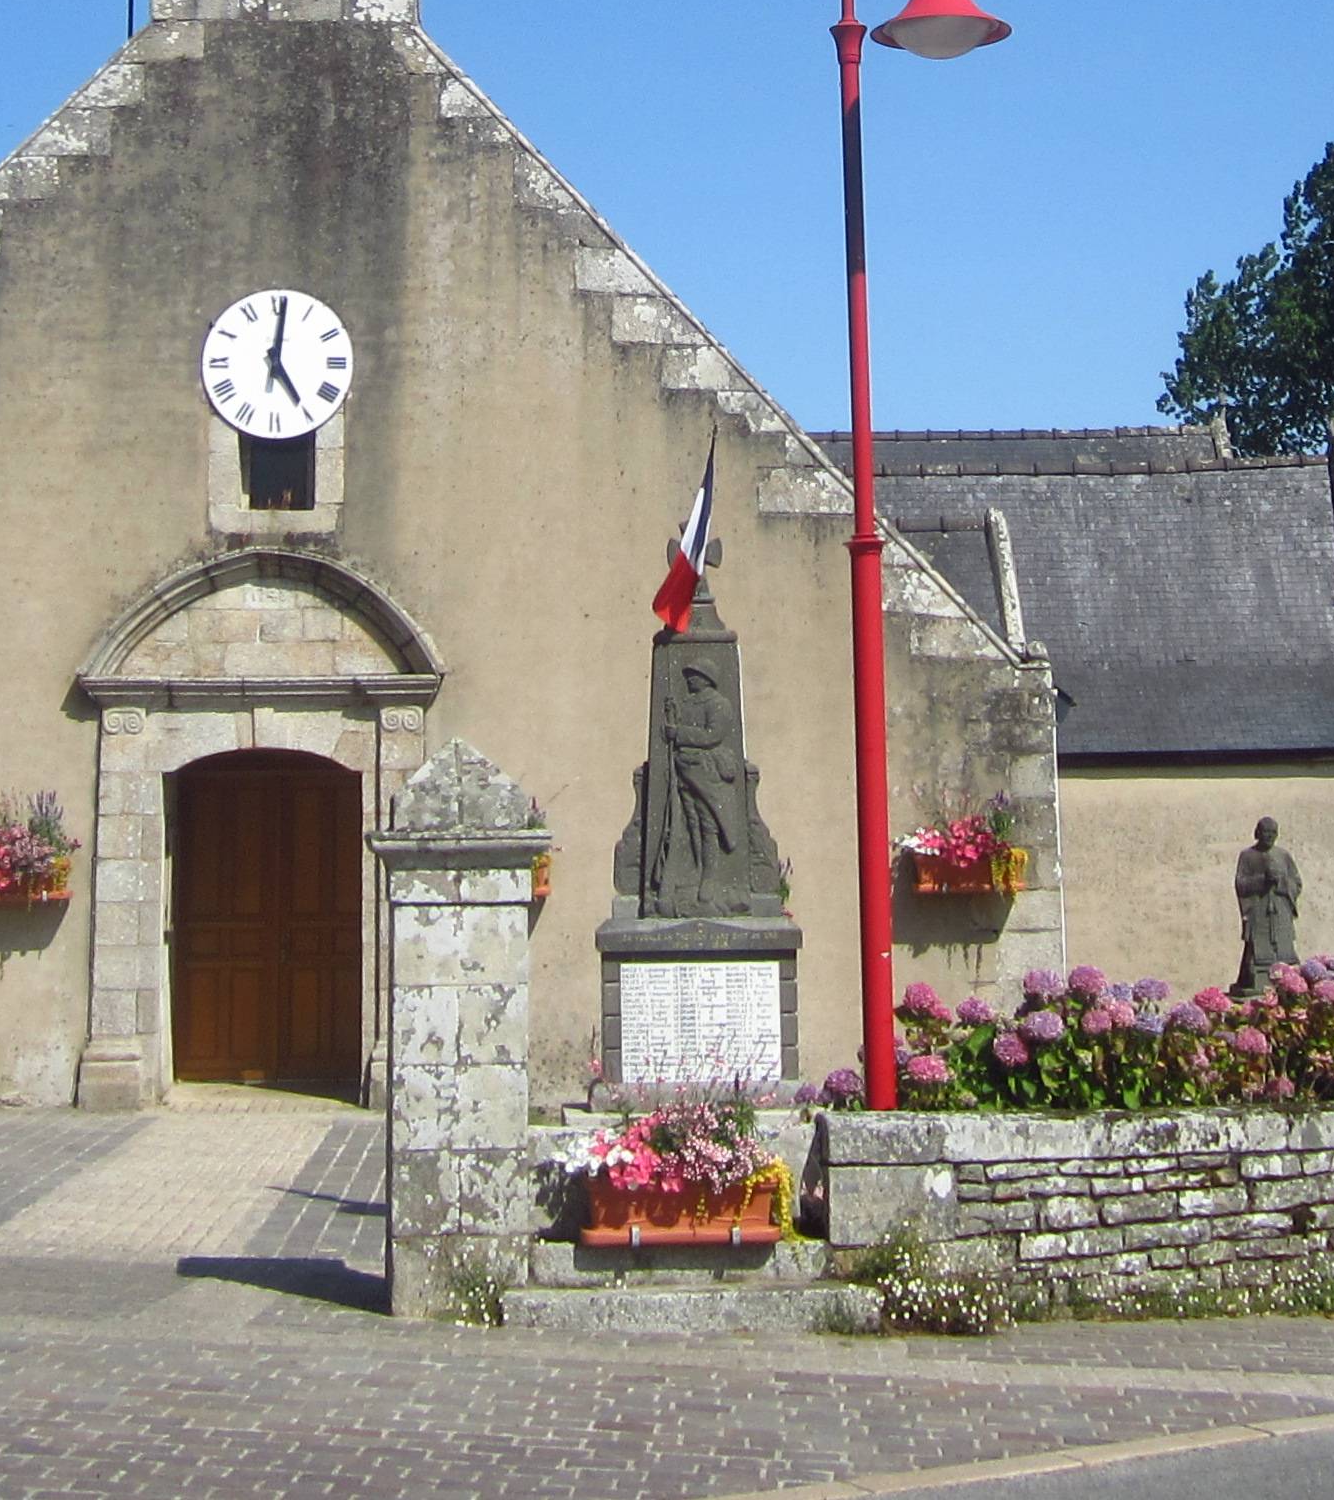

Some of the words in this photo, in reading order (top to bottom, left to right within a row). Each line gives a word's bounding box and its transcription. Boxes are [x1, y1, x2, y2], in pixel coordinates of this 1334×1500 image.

[302, 304, 314, 322] I
[319, 327, 340, 343] II
[208, 356, 230, 369] IX
[326, 356, 347, 370] III
